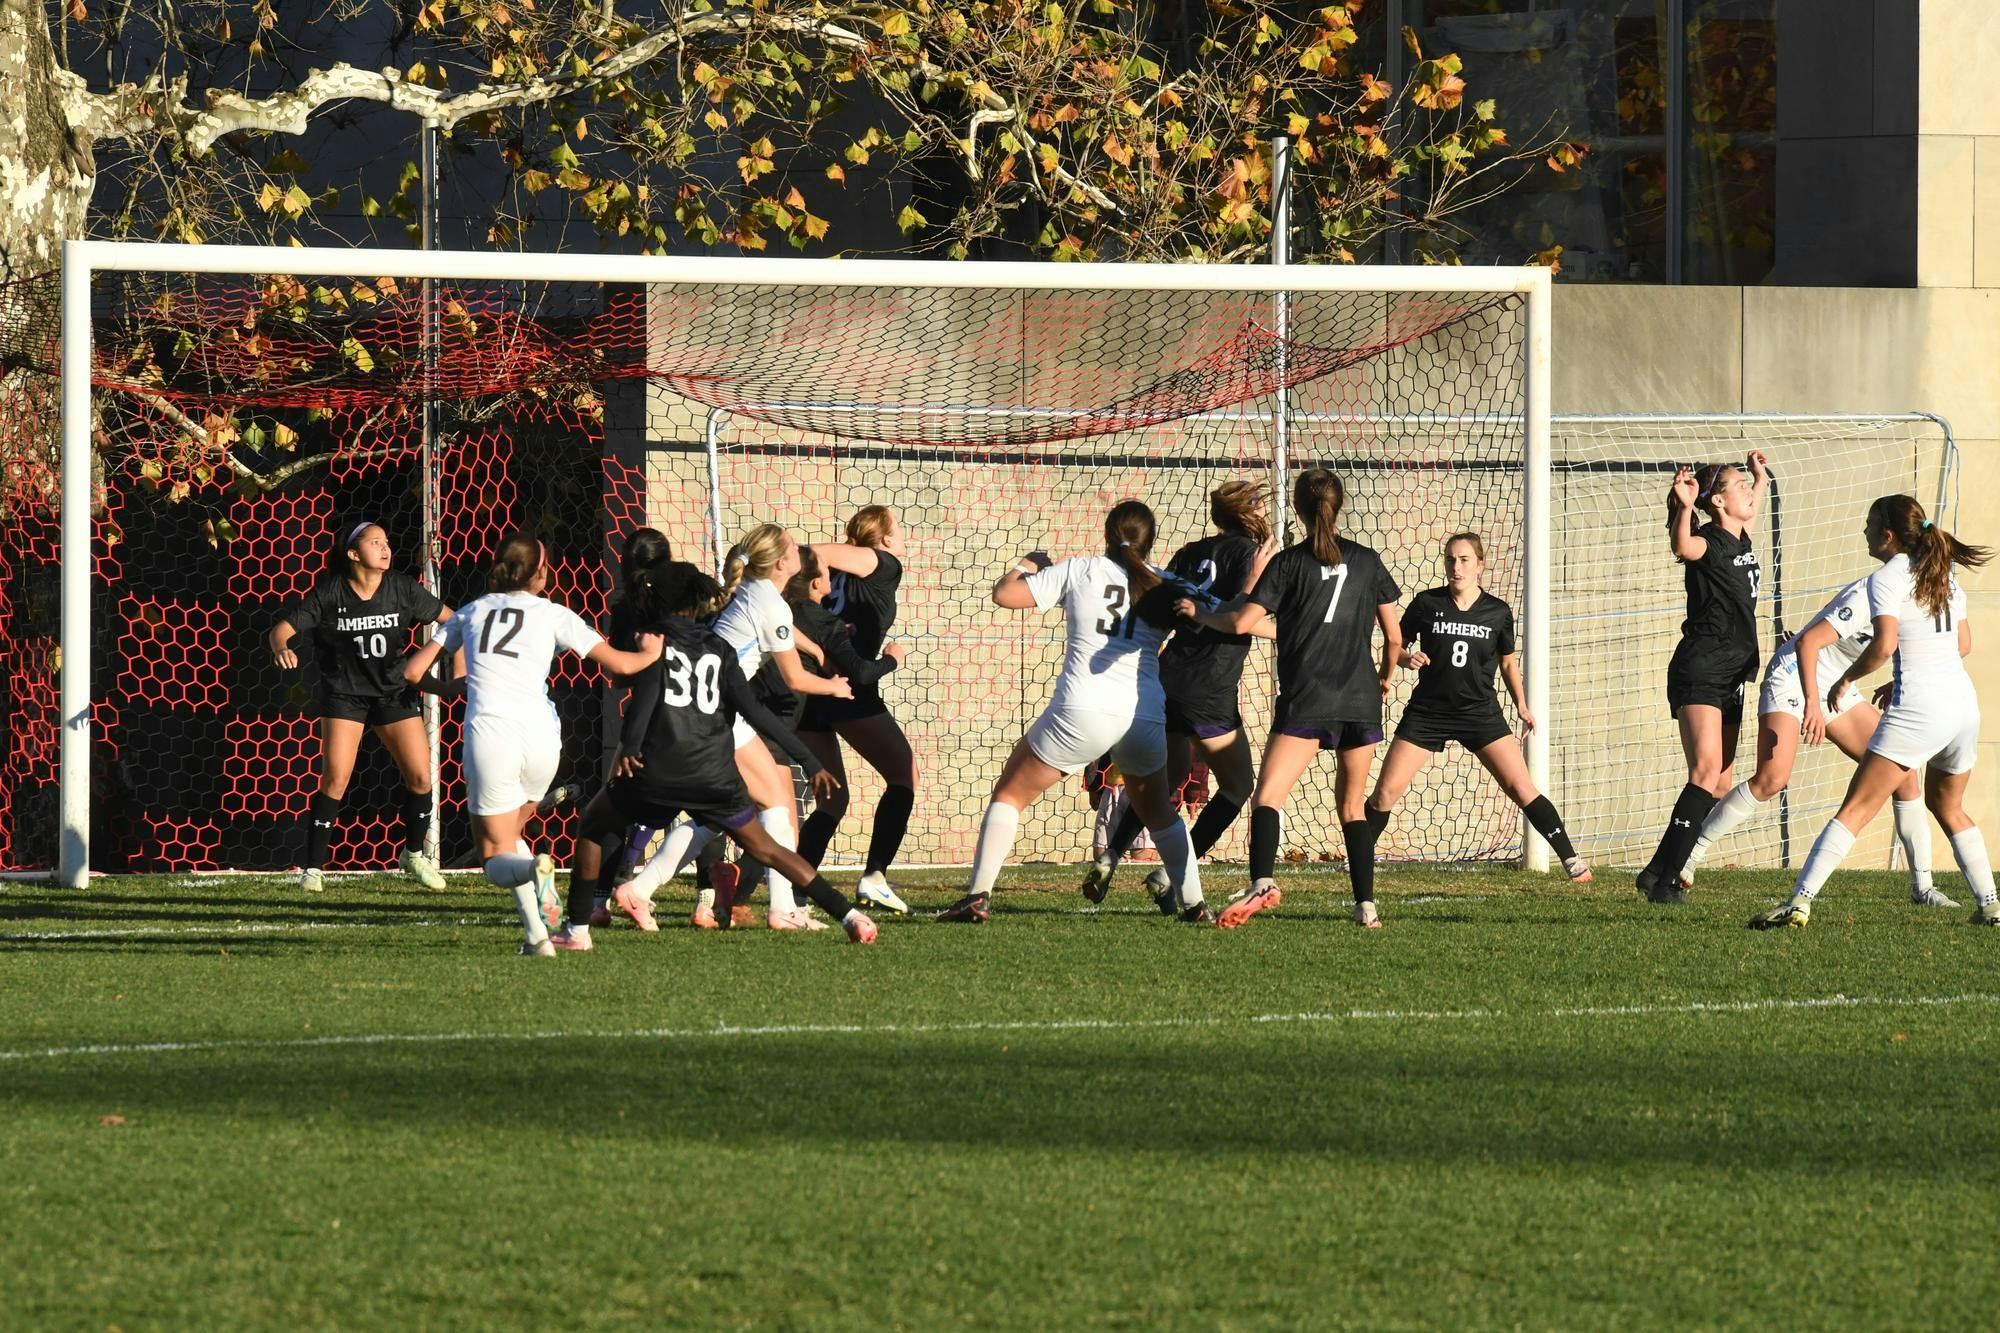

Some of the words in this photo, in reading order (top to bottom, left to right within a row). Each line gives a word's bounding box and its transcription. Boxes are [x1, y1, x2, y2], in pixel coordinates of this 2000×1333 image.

[1096, 584, 1137, 640] 31
[1321, 564, 1348, 623] 7
[336, 613, 400, 631] AMHERST
[479, 607, 525, 659] 12
[1431, 621, 1493, 639] AMHERST
[353, 633, 387, 659] 10
[1451, 640, 1469, 668] 8
[664, 646, 722, 715] 30
